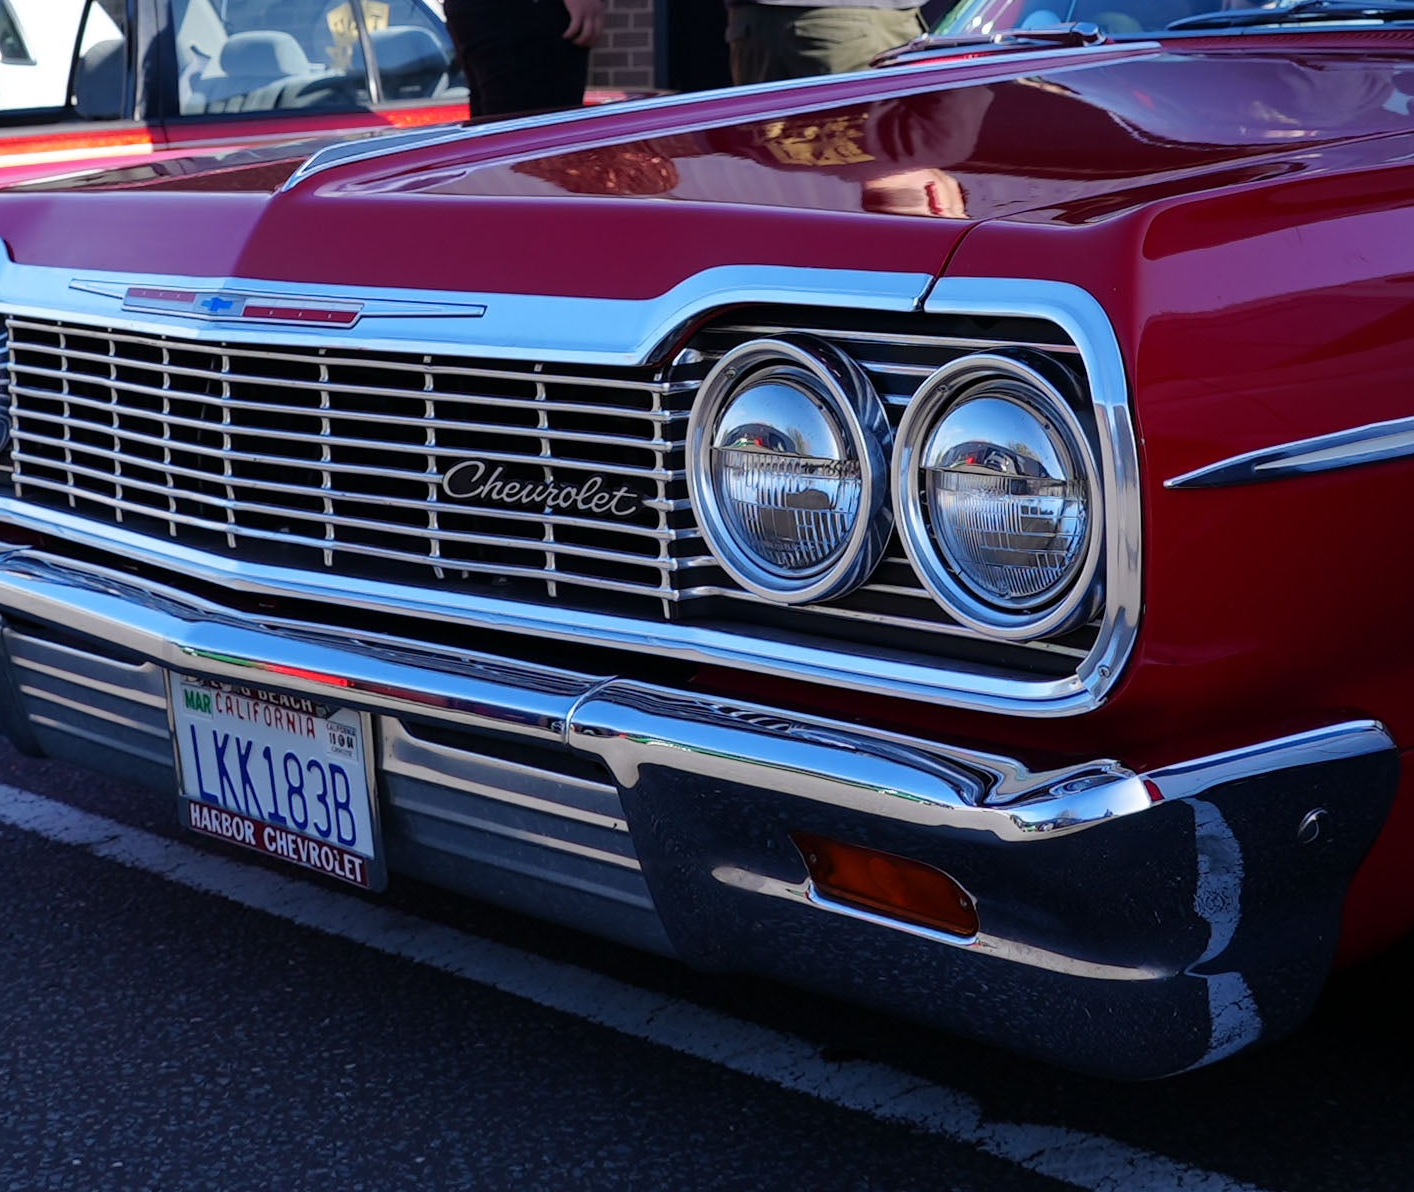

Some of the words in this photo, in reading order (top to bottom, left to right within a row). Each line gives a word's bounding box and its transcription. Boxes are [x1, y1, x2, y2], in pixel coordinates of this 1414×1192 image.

[441, 460, 638, 517] Chevrolet
[184, 689, 212, 714] MAR
[215, 691, 316, 739] CALIFORNIA
[190, 723, 357, 847] LKK183B
[189, 802, 257, 846] HARBOR
[263, 826, 363, 884] CHEVROLET
